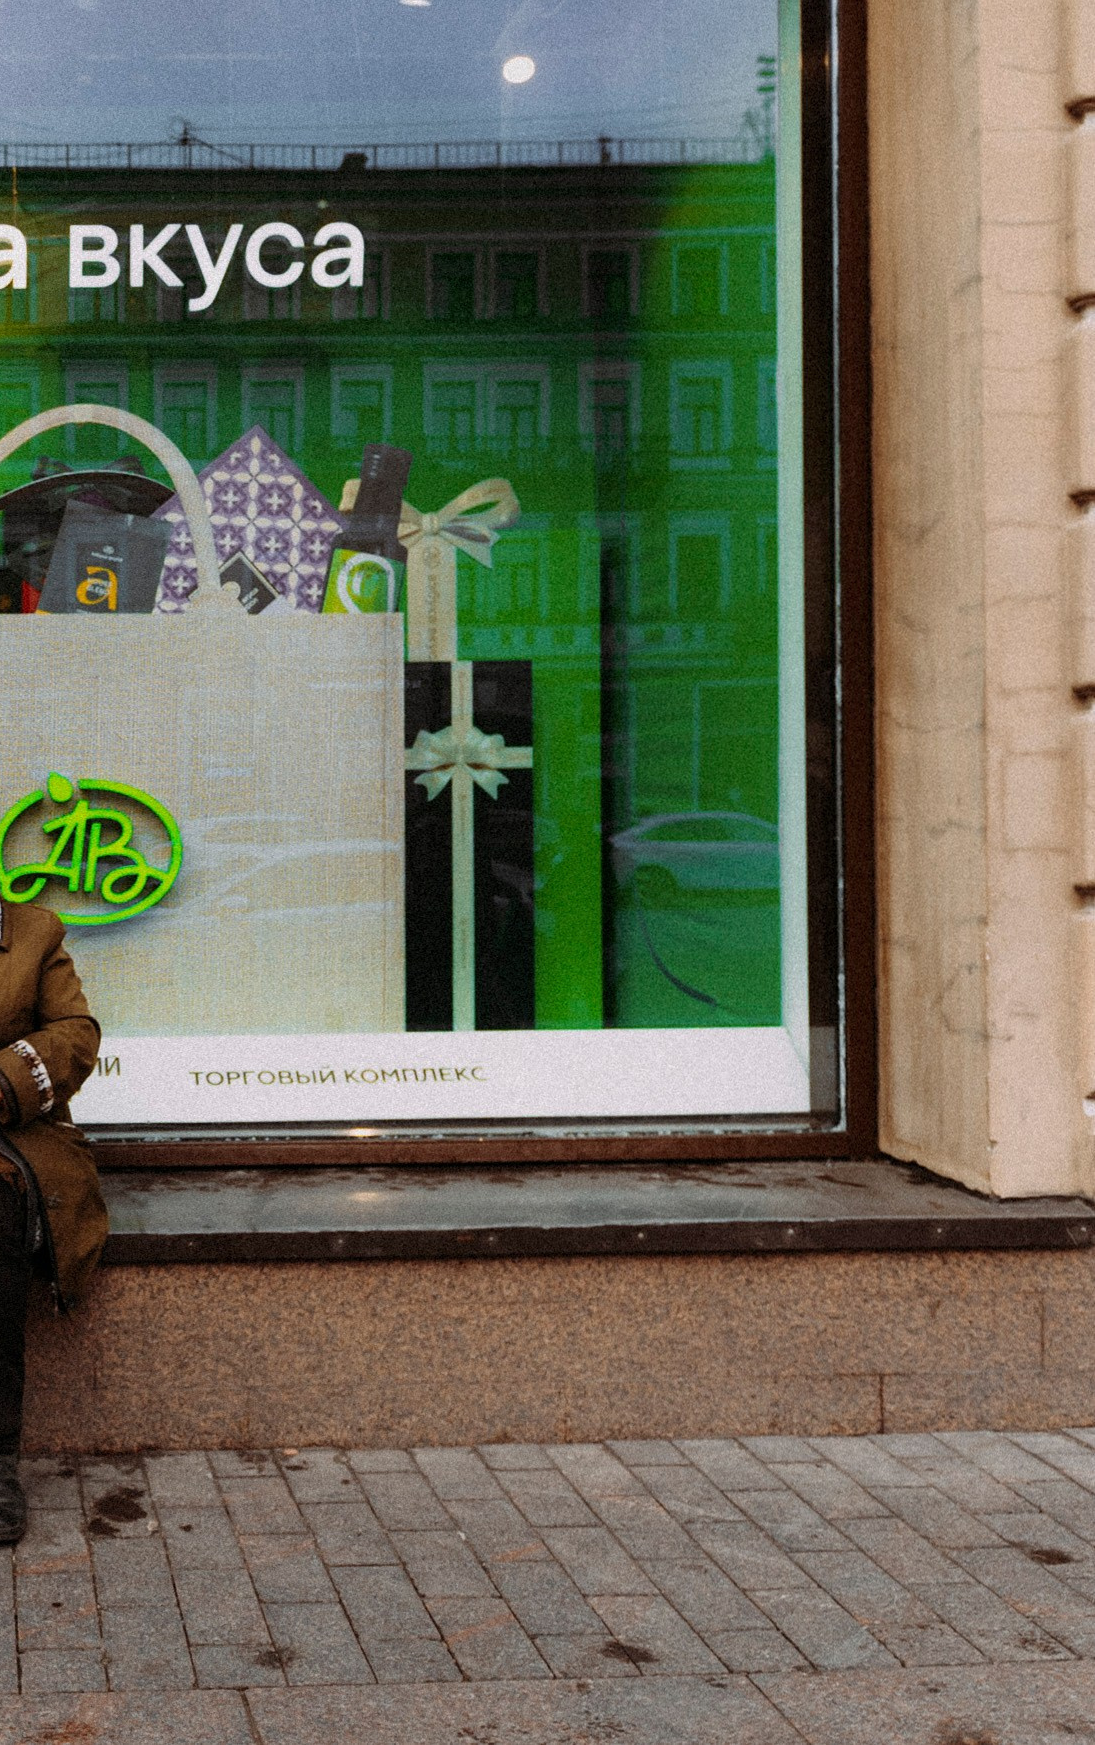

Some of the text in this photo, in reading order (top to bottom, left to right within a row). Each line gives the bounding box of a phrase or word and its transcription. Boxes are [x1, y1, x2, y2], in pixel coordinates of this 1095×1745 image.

[68, 221, 366, 311] вкуса
[188, 1065, 488, 1086] ТОРГОВЫЙ КОМПЛЕКС
